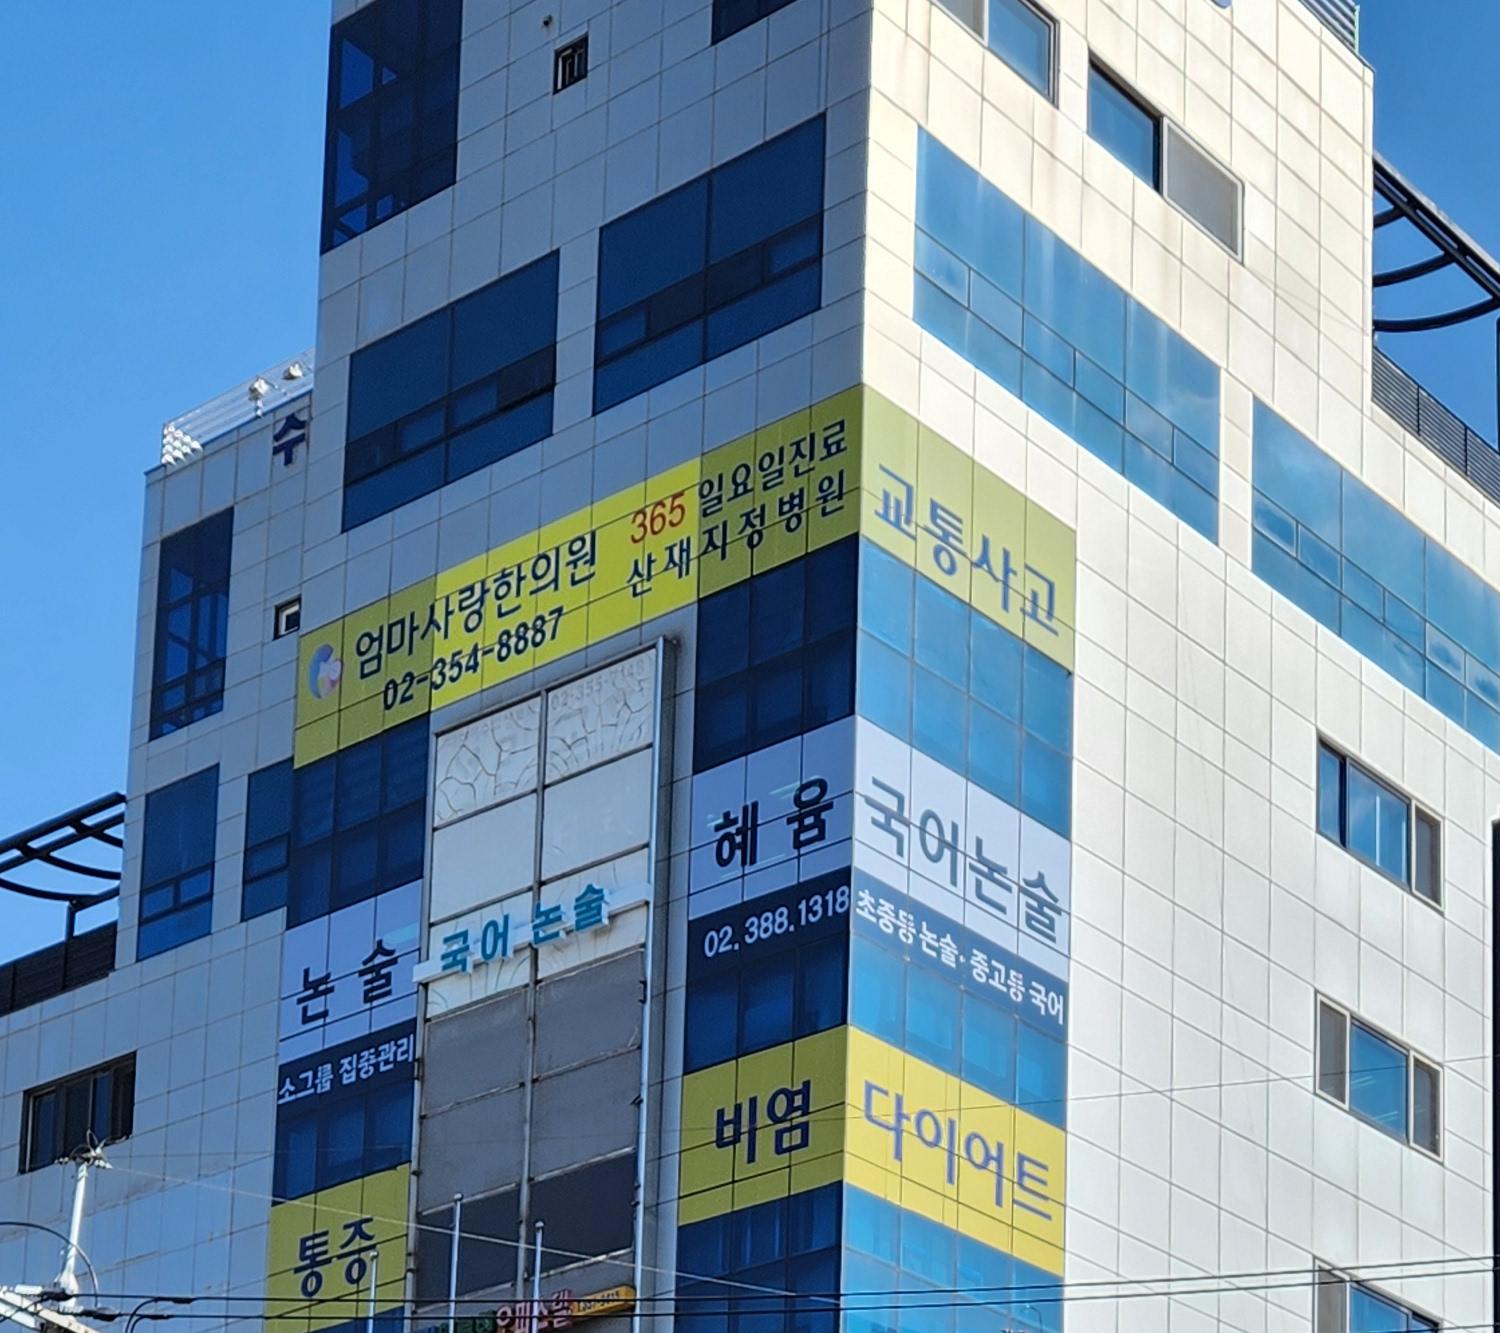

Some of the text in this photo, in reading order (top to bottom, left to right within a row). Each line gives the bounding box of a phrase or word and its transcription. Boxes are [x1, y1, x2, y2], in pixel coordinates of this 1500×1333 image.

[273, 413, 306, 466] 수
[629, 419, 848, 546] 365 일요일진료
[626, 471, 846, 598] 산재지정병원
[874, 464, 1059, 638] 교통사고
[355, 529, 598, 684] 엄마사랑한의원
[383, 608, 565, 711] 02-354-8887
[864, 774, 1064, 945] 국어논술
[441, 884, 606, 973] 국어 논술
[704, 884, 849, 958] 02.388.1318
[856, 889, 914, 945] 초중등
[970, 949, 1025, 1003] 중고등
[1029, 981, 1064, 1025] 국어
[277, 1034, 414, 1105] 소그룹 집중관리
[715, 1079, 813, 1165] 비염
[864, 1079, 1053, 1221] 다이어트
[295, 1218, 378, 1301] 통증
